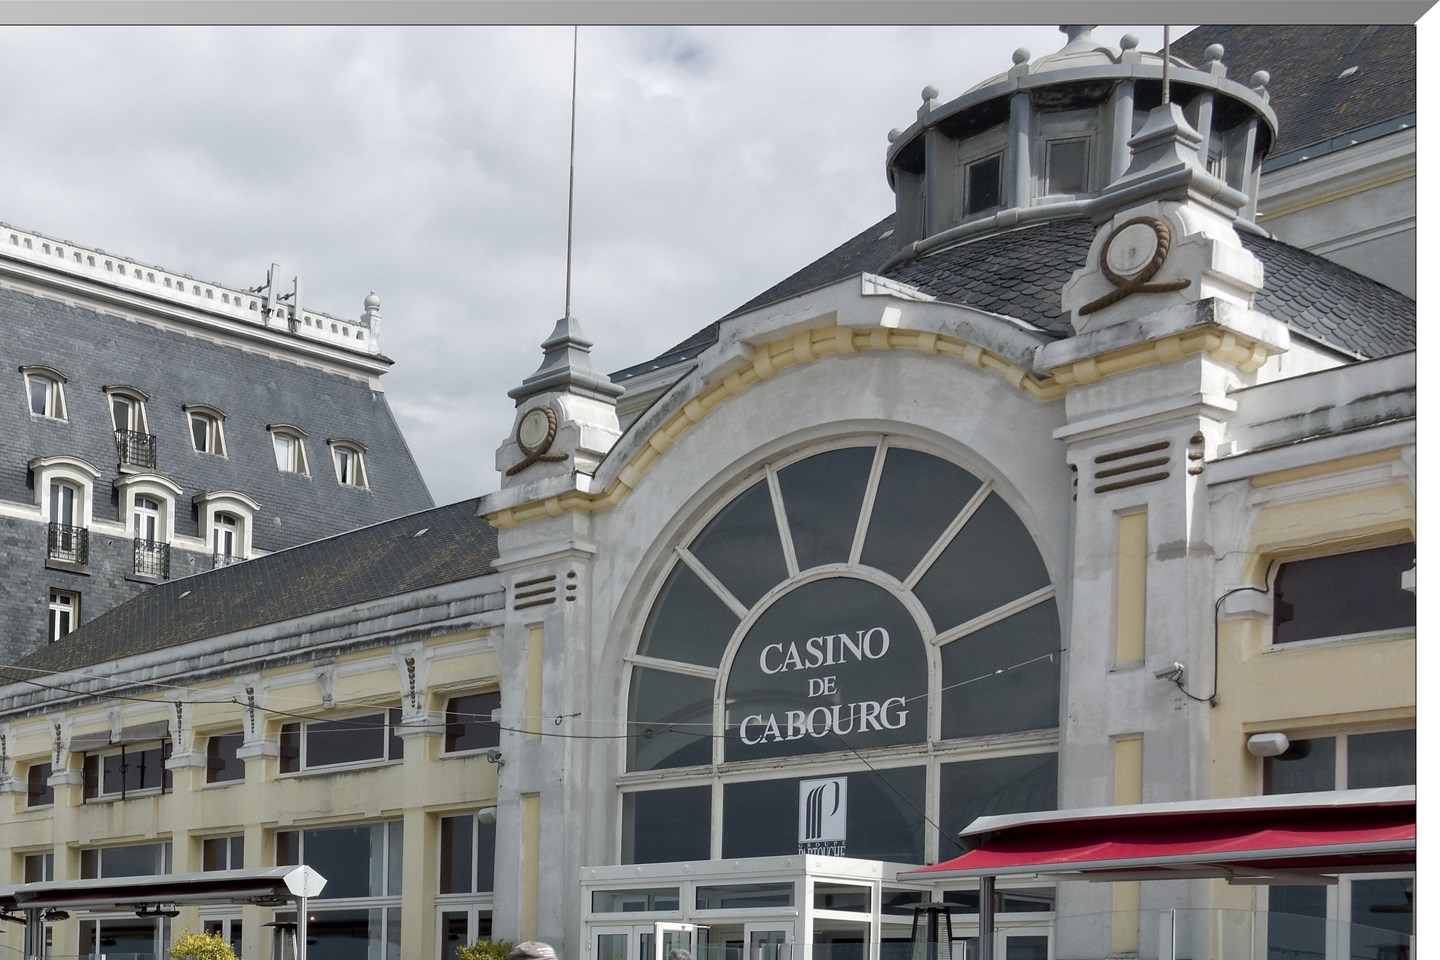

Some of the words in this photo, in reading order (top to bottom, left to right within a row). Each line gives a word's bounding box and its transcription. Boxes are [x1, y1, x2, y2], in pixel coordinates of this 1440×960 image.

[759, 626, 890, 675] CASINO
[807, 675, 838, 698] DE
[739, 696, 910, 746] CABOURG
[798, 840, 847, 848] GROUPE
